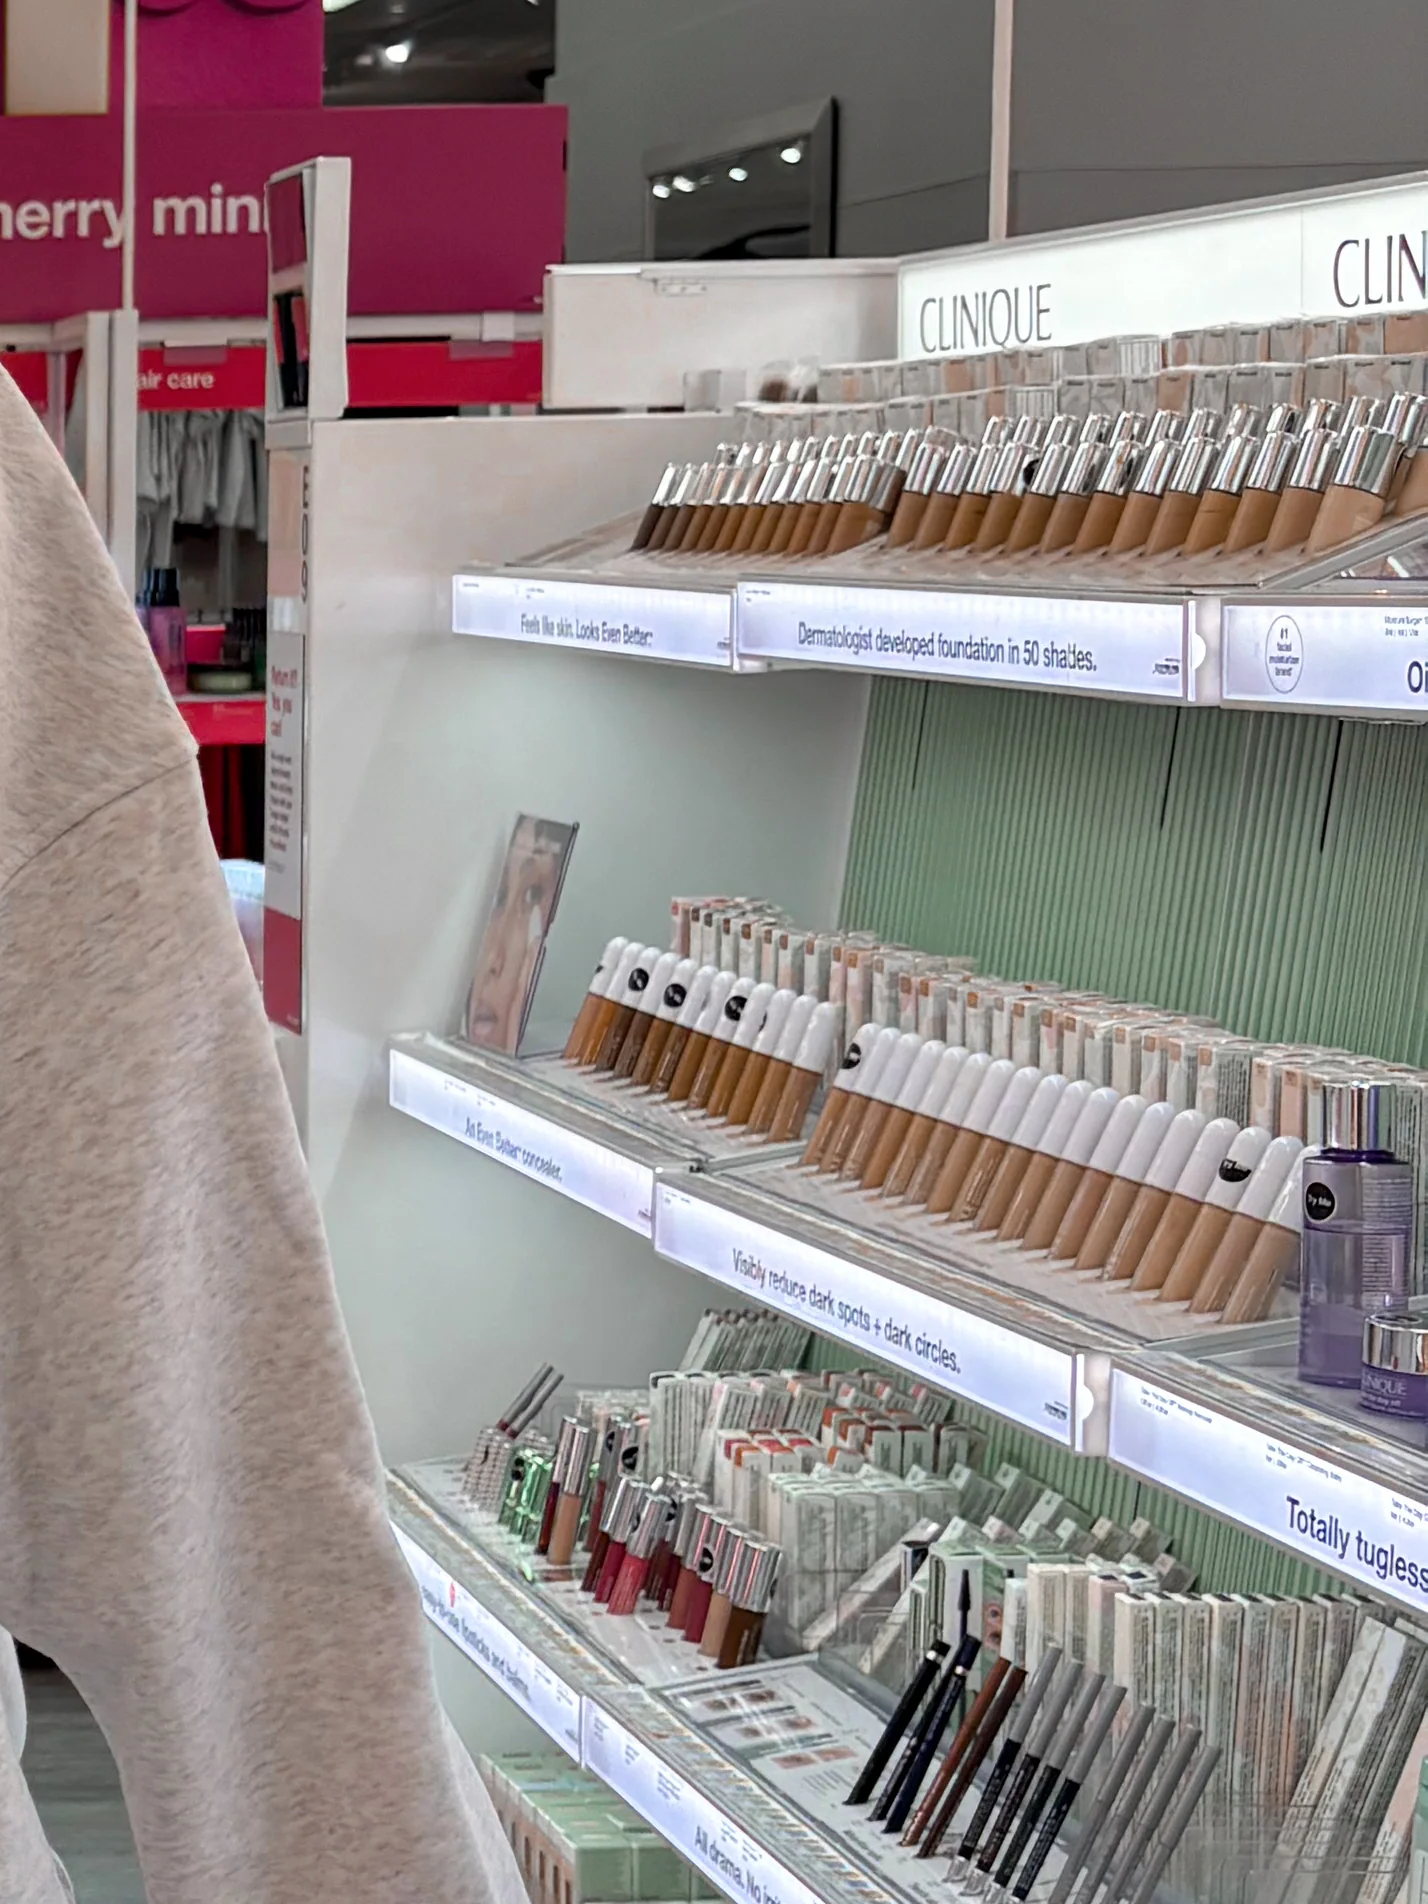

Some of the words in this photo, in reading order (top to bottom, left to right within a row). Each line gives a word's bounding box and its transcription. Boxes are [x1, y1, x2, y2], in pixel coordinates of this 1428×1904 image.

[919, 284, 1052, 352] CLINIQUE
[166, 369, 215, 390] care
[575, 618, 600, 643] Looks
[601, 621, 622, 645] Even
[797, 620, 874, 655] Dermatologist
[875, 626, 935, 662] developed
[937, 631, 1005, 663] foundation
[1008, 637, 1020, 665] in
[1022, 638, 1040, 667] 50
[1043, 642, 1098, 673] shades.
[732, 1246, 766, 1290] Visibly
[768, 1269, 807, 1303] reduce
[808, 1283, 835, 1317] dark
[837, 1298, 871, 1333] spots
[884, 1317, 912, 1352] dark
[915, 1330, 962, 1375] circles.
[1285, 1495, 1351, 1560] Totally
[1355, 1529, 1428, 1597] tugless
[746, 1870, 763, 1902] No
